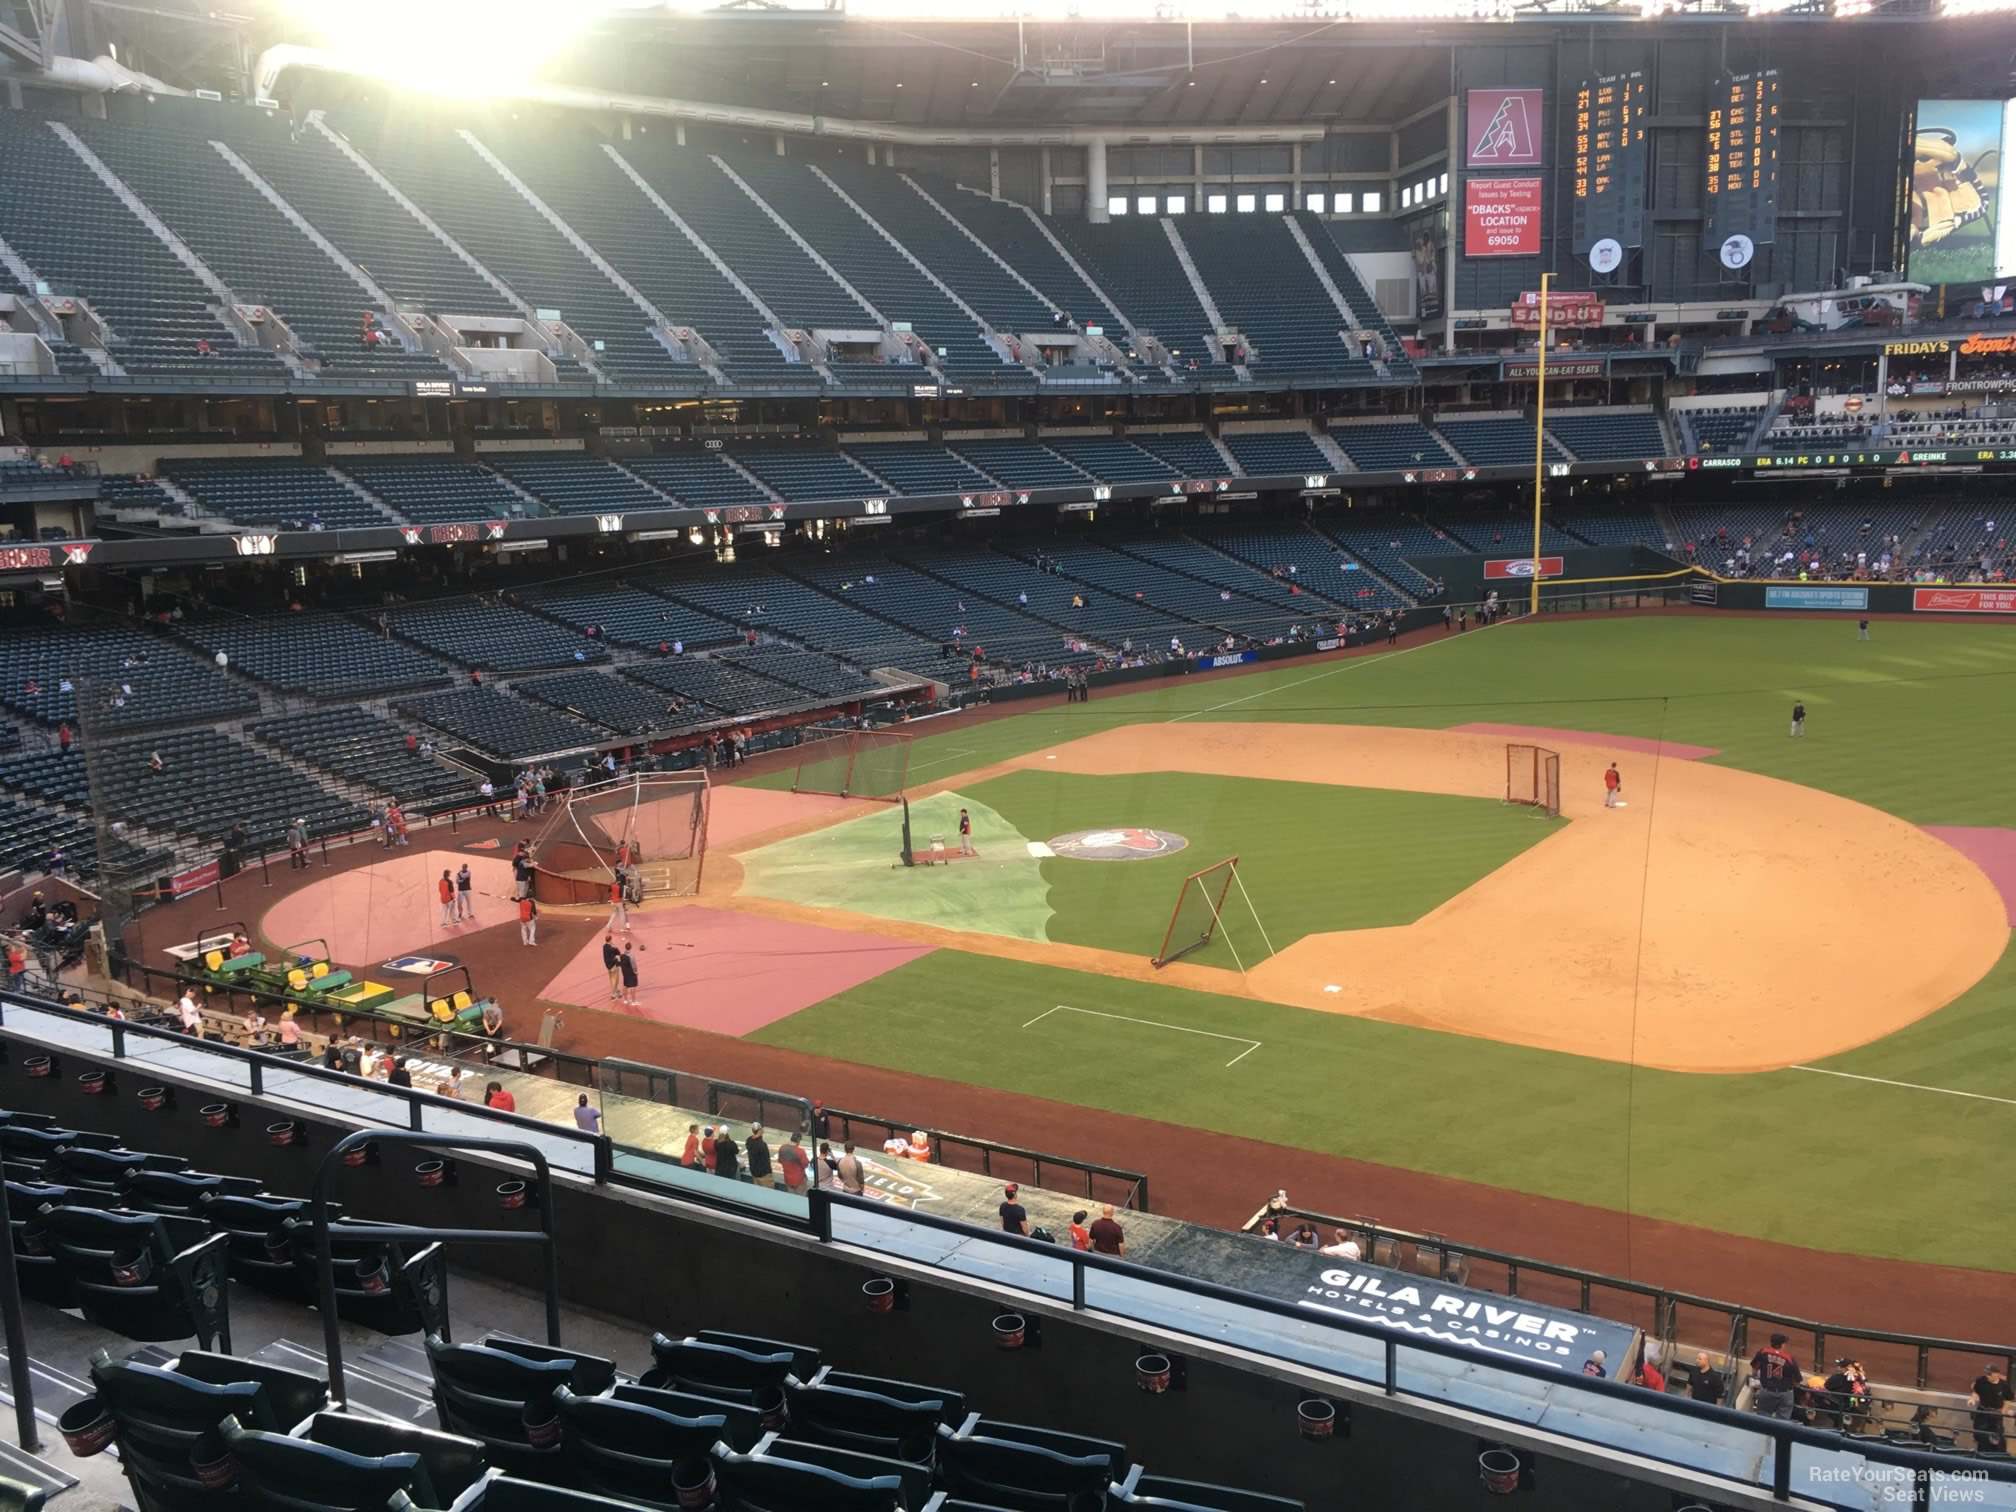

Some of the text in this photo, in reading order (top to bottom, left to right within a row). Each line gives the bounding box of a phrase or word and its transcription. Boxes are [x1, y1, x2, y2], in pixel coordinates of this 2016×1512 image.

[1757, 81, 1763, 90] 2
[1578, 90, 1589, 99] 44
[1757, 91, 1762, 99] 2
[1578, 100, 1589, 109] 27
[1624, 92, 1629, 101] 3
[1756, 104, 1762, 112] 2
[1578, 112, 1588, 122] 28
[1710, 120, 1720, 129] 56
[1756, 113, 1761, 121] 2
[1578, 122, 1588, 131] 34
[1623, 115, 1628, 124] 3
[1578, 135, 1588, 144] 55
[1622, 128, 1628, 136] 2
[1709, 132, 1720, 142] 52
[1578, 144, 1587, 153] 32
[1577, 157, 1587, 166] 52
[1709, 154, 1719, 163] 30
[1577, 166, 1587, 175] 44
[1709, 164, 1719, 172] 38
[1576, 179, 1586, 188] 33
[1708, 176, 1718, 185] 35
[1500, 190, 1507, 198] by
[1576, 188, 1586, 196] 45
[1481, 216, 1527, 226] LOCATION
[1488, 236, 1519, 245] 69050
[1516, 307, 1600, 320] SANDLOT
[1885, 341, 1949, 355] FRIDAY'S
[1576, 365, 1599, 374] SEATS
[1703, 459, 1741, 467] CARRASCO
[1913, 452, 1946, 461] GREINKE
[1212, 653, 1243, 667] ABSOLUT.
[863, 1174, 914, 1194] IELD
[1320, 1269, 1420, 1305] GILA
[1430, 1293, 1579, 1344] RIVER
[1307, 1285, 1570, 1356] HOTELS & CASINOS
